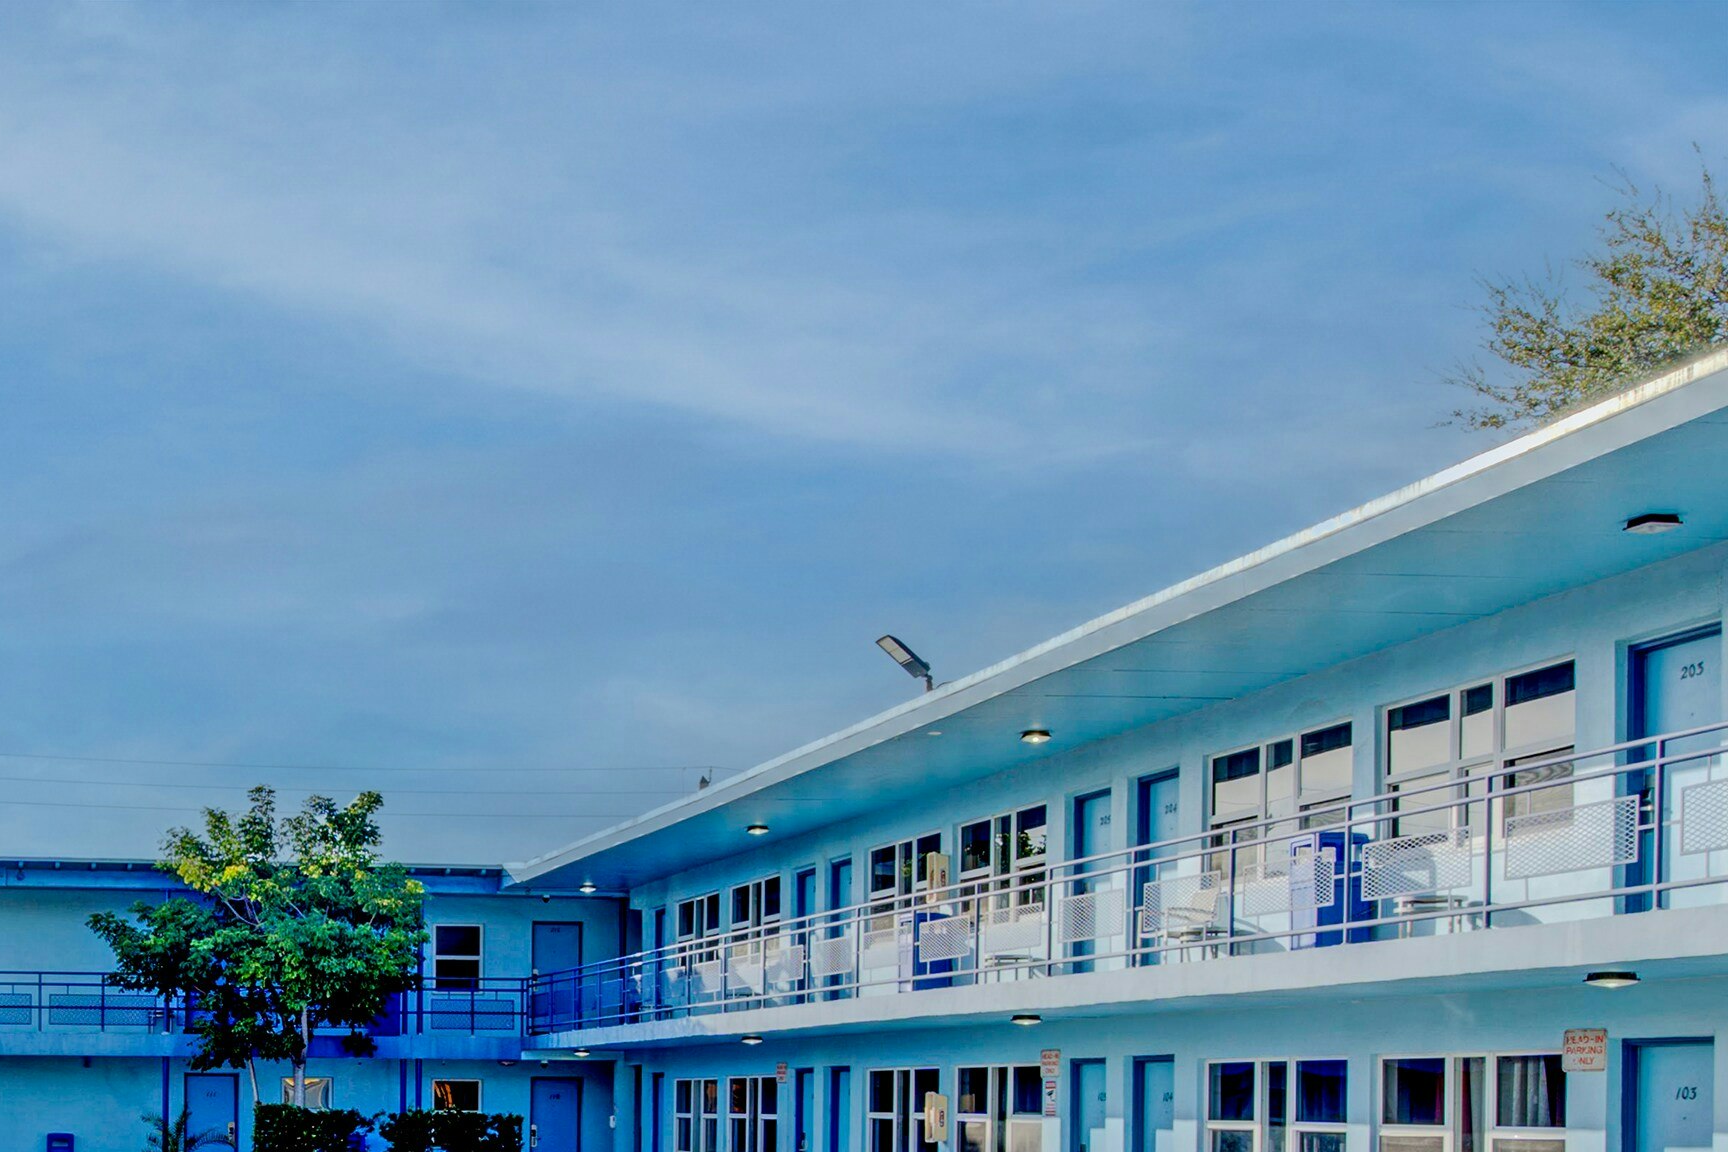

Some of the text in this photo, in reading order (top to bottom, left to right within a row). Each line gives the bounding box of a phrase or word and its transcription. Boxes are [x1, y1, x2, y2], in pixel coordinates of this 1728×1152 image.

[1566, 1035, 1604, 1044] HEAD-IN
[1566, 1045, 1603, 1054] PARKING
[1572, 1057, 1595, 1065] NLY
[1675, 1086, 1698, 1100] 103
